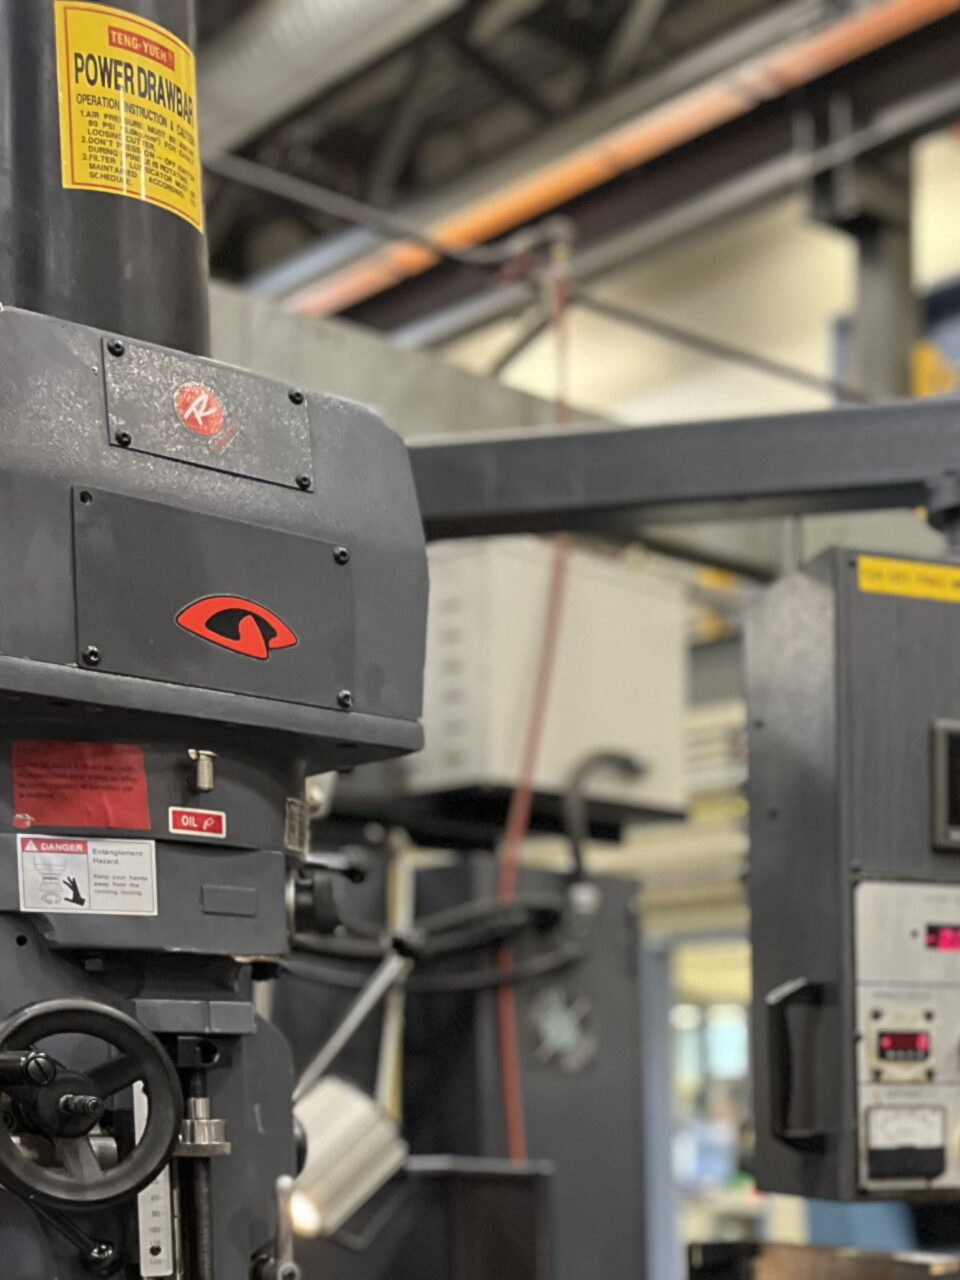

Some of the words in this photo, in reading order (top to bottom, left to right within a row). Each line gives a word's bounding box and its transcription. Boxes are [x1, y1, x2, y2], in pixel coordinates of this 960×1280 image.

[111, 30, 168, 63] TENG-YUEH
[74, 52, 135, 95] POWER
[137, 66, 193, 123] DRAWBAR
[76, 93, 120, 110] OPERATION
[181, 814, 198, 827] OIL
[40, 842, 84, 853] DANGER
